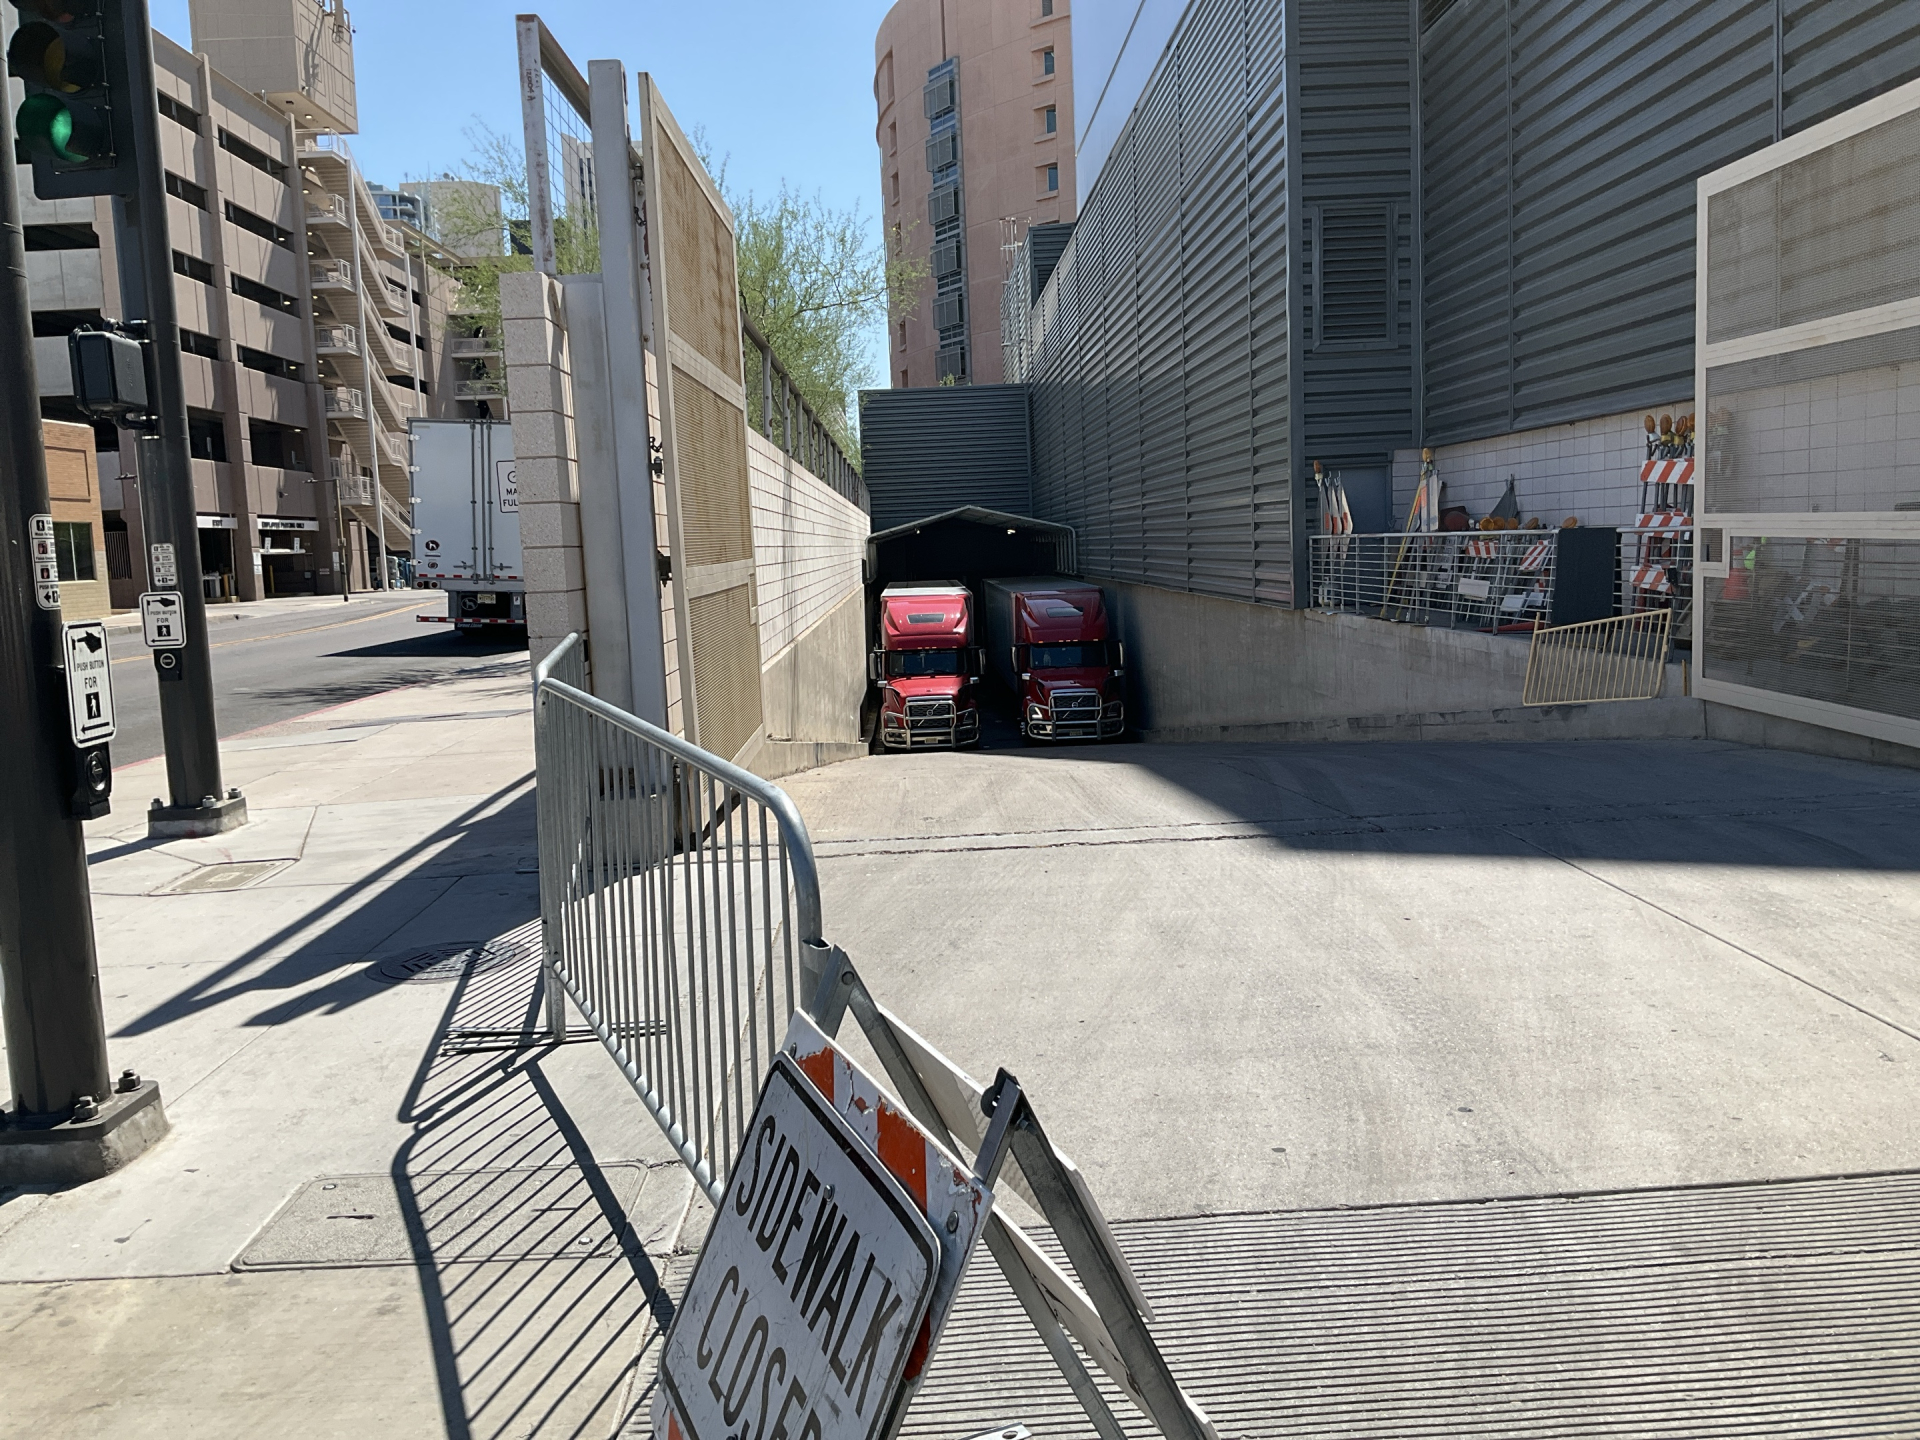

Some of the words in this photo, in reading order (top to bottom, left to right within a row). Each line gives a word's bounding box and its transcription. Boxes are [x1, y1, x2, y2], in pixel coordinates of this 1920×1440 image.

[506, 488, 517, 496] MA
[503, 499, 519, 507] FUL
[77, 661, 89, 672] PUSH
[89, 659, 105, 671] BUTTON
[84, 676, 98, 690] FOR
[735, 1114, 903, 1420] SIDEWALK
